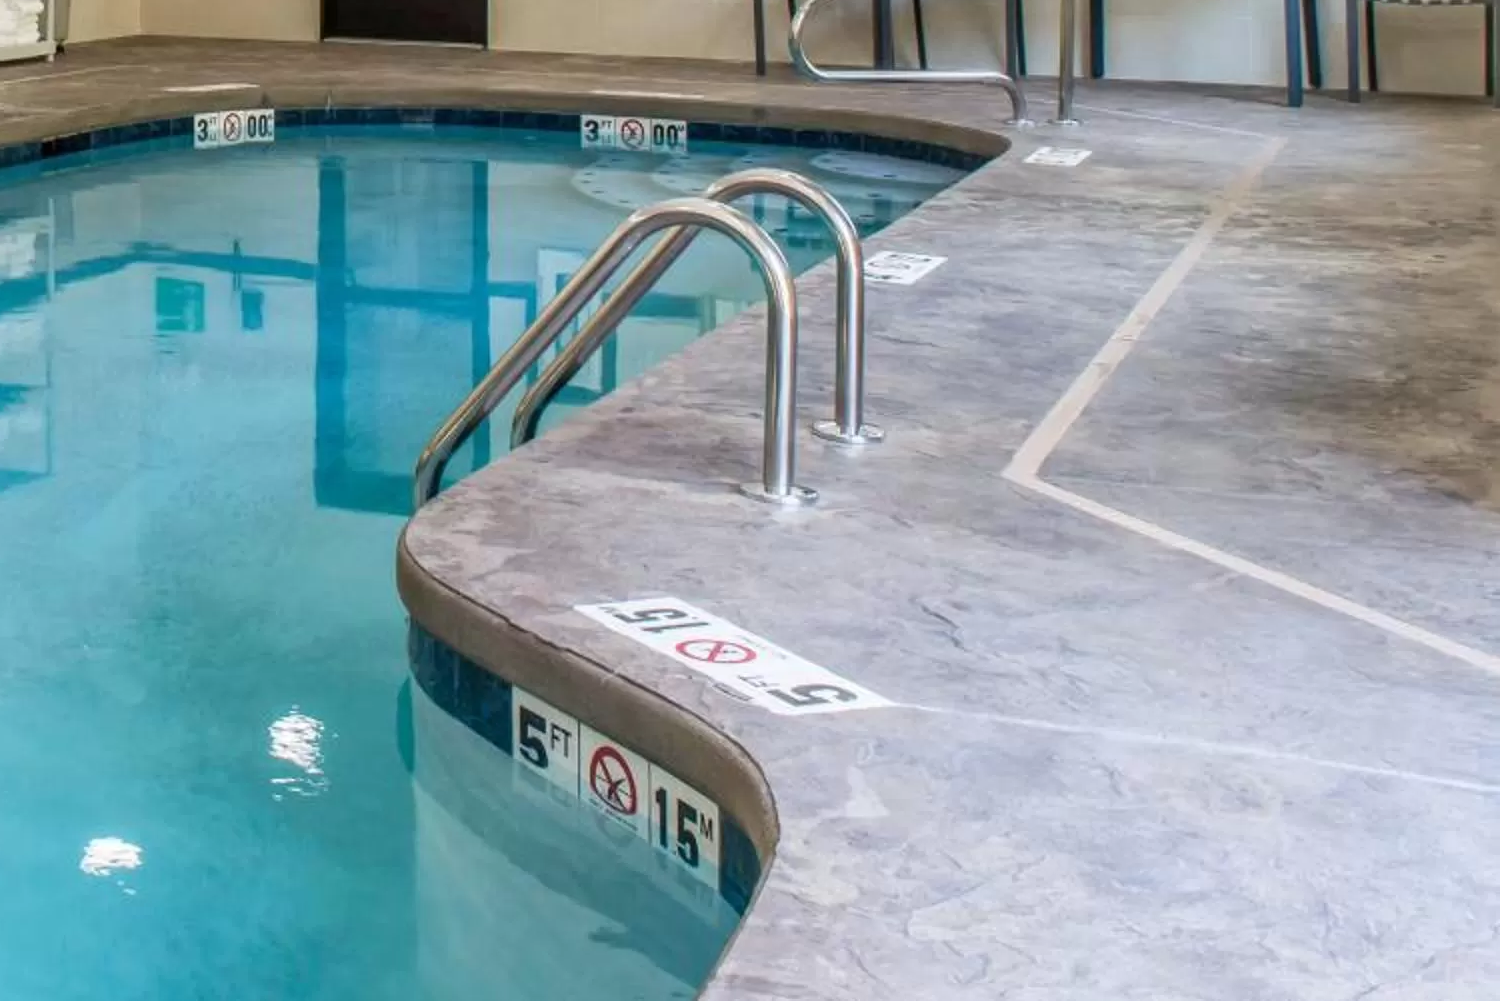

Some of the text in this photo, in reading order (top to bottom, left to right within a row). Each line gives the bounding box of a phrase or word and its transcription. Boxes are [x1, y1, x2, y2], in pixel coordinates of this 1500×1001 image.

[584, 119, 598, 142] 3
[766, 683, 859, 707] 5
[519, 705, 573, 768] 5 FT
[700, 811, 714, 843] M
